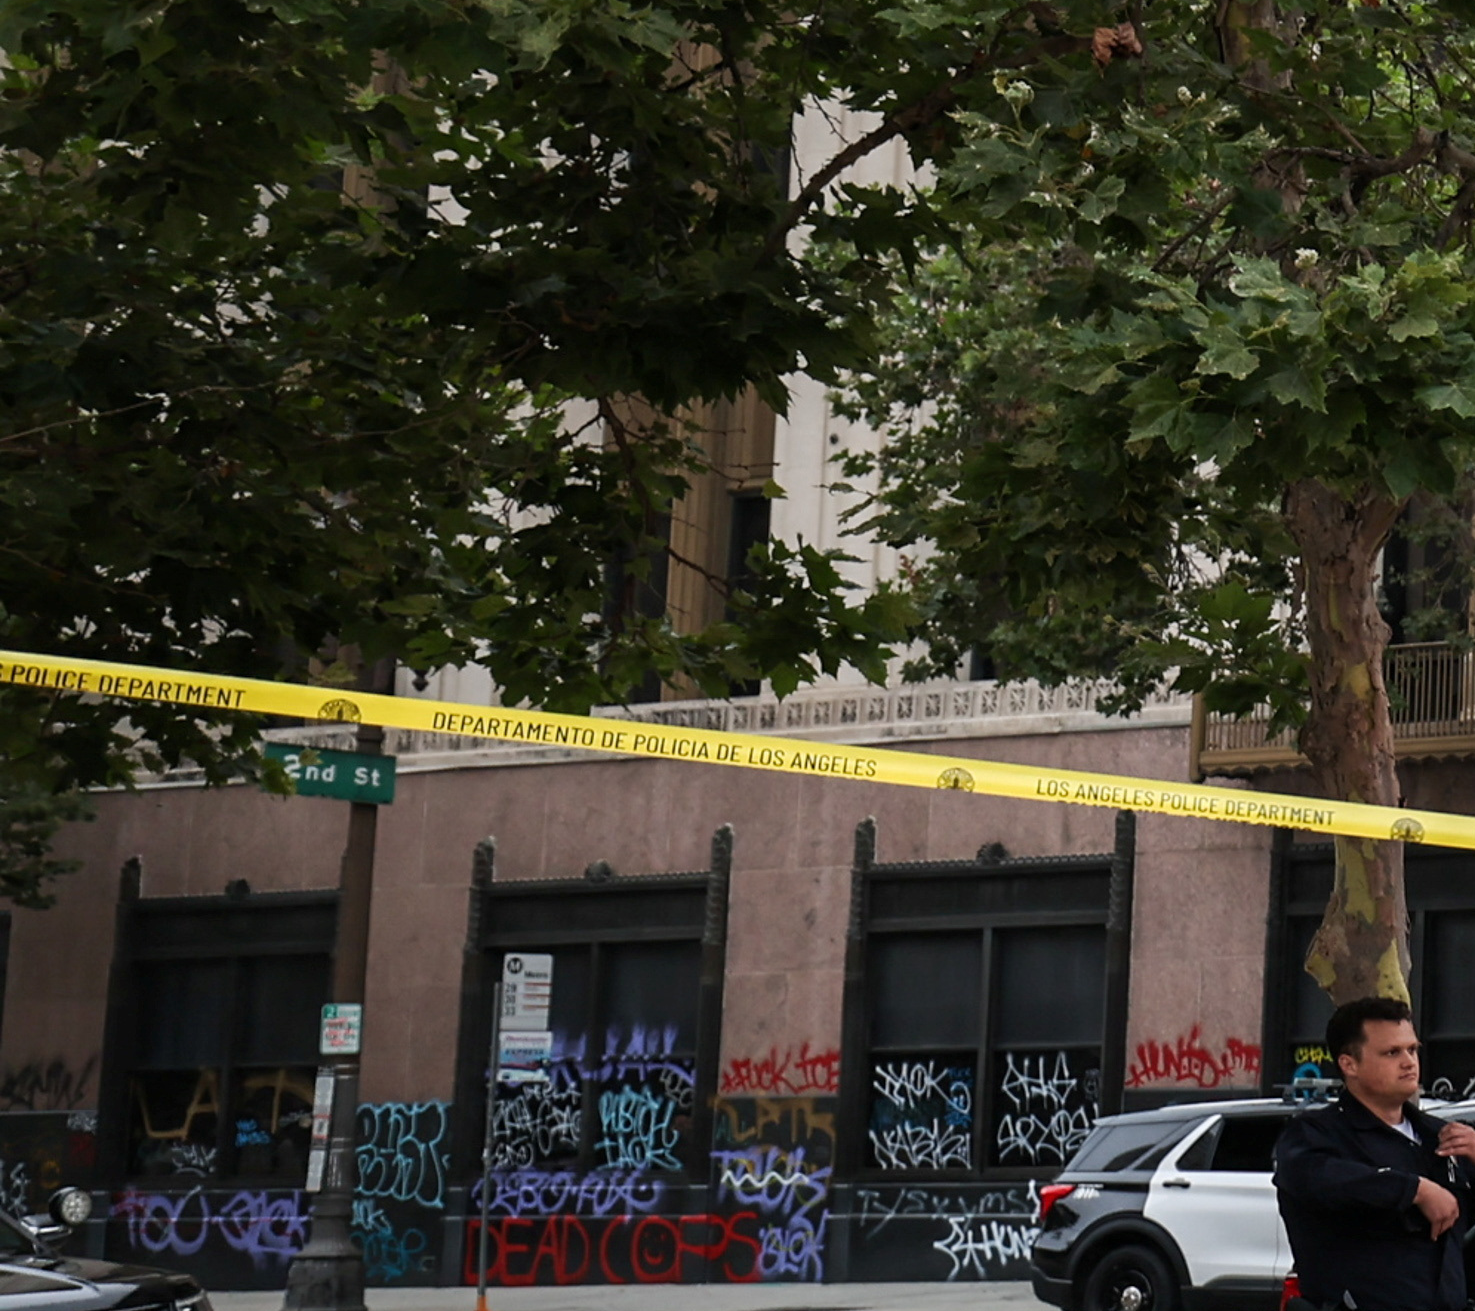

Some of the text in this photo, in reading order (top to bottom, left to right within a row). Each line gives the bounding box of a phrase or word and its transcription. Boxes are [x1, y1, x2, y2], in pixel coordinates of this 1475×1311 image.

[11, 664, 246, 707] POLICE DEPARTMENT
[433, 711, 877, 777] DEPARTAMENTO DE POLICIA DE LOS ANGELES
[283, 754, 381, 786] 2nd St
[1037, 779, 1069, 797] LOS
[1075, 784, 1154, 807] ANGELES
[1160, 792, 1218, 813] POLICE
[1225, 800, 1336, 826] DEPARTMENT
[464, 1211, 762, 1286] DEAD COPS
